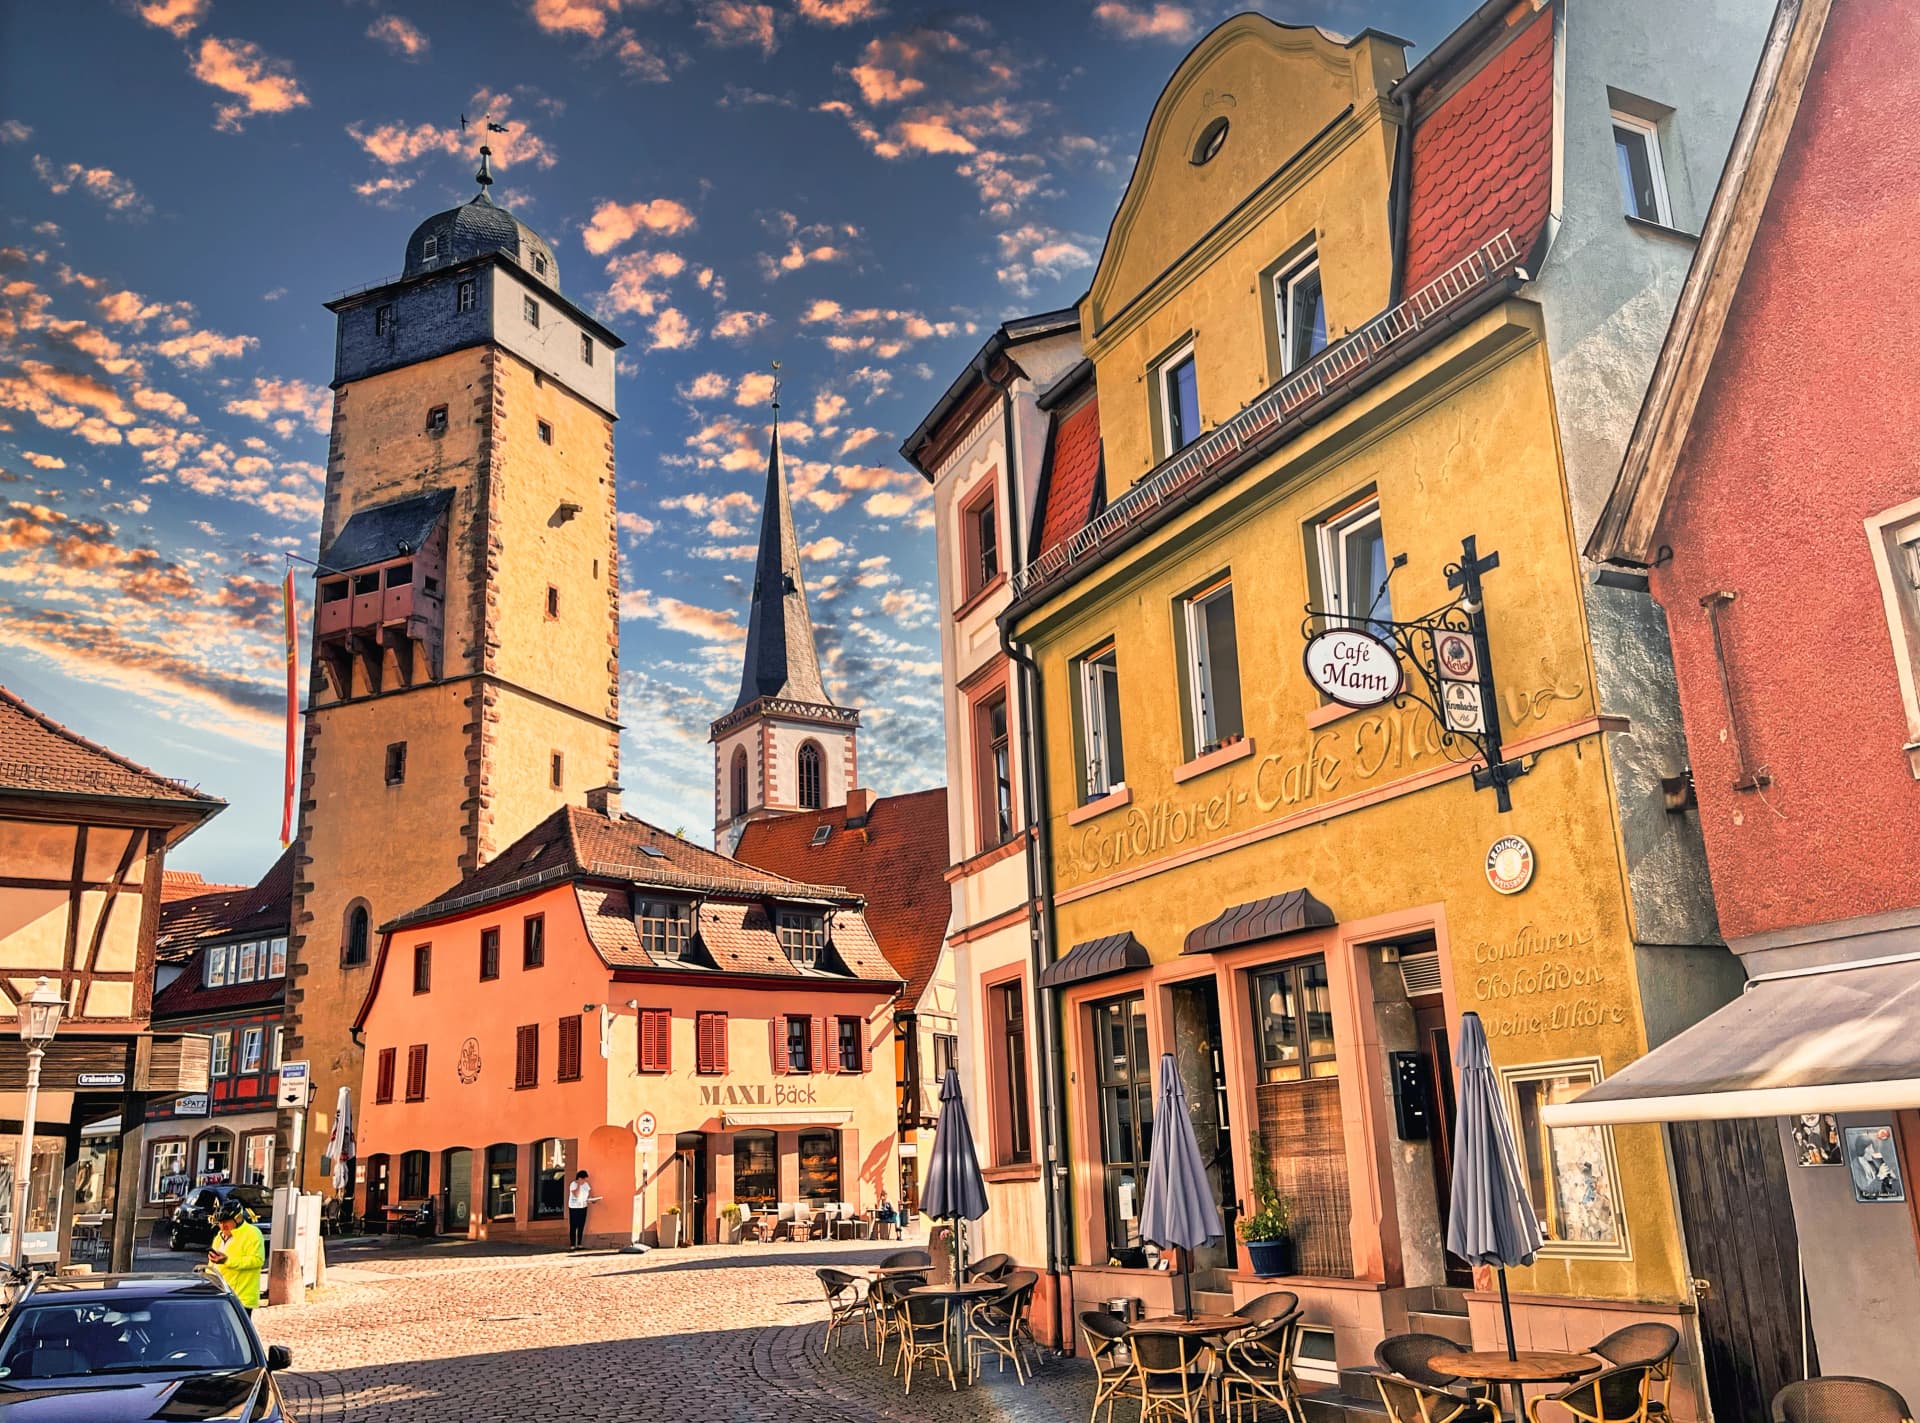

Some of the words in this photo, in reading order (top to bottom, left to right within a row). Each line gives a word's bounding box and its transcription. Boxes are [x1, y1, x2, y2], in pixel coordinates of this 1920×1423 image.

[1333, 641, 1370, 666] Café
[1447, 656, 1470, 671] Keiler
[1322, 663, 1390, 692] Mann
[1446, 701, 1479, 712] Krombacher
[1488, 839, 1528, 865] ERDINGER
[699, 1084, 772, 1105] MAXL
[775, 1083, 817, 1106] Bäck
